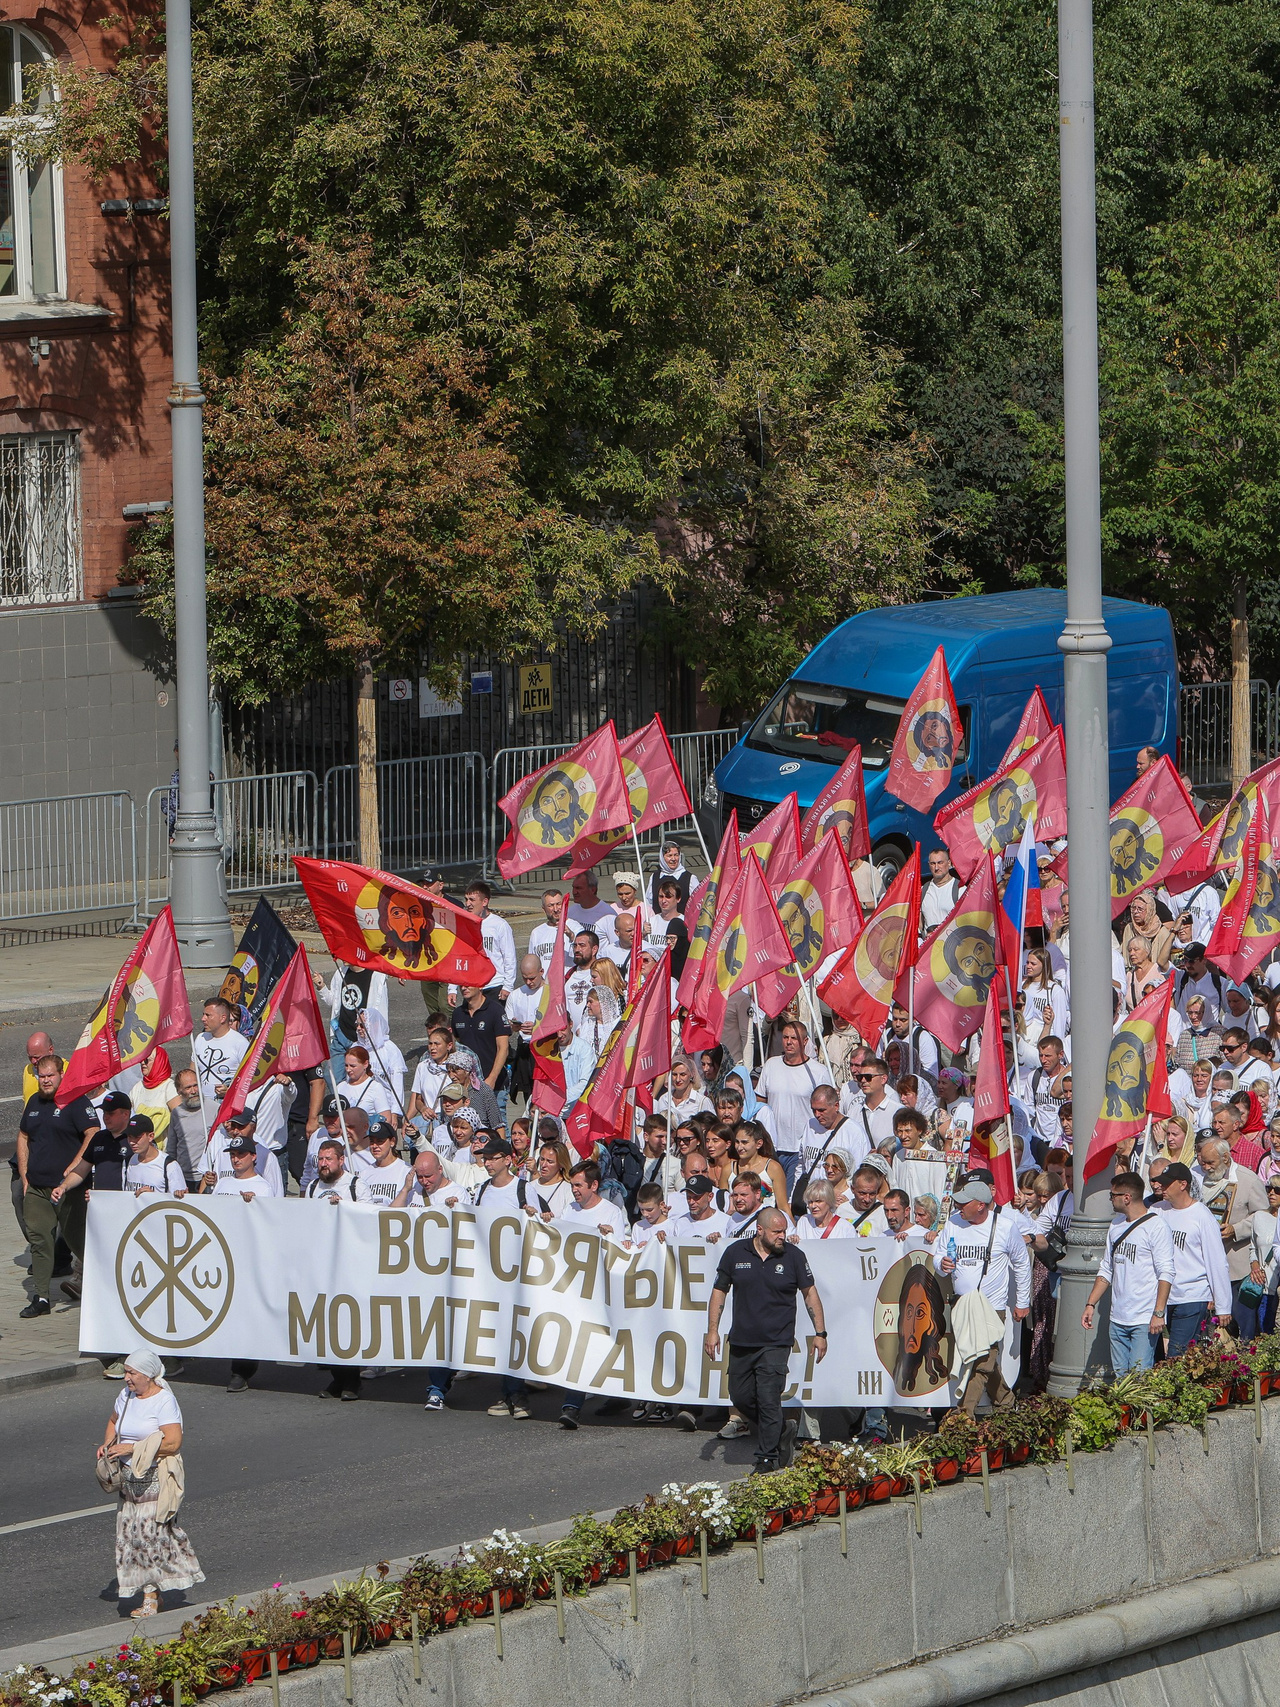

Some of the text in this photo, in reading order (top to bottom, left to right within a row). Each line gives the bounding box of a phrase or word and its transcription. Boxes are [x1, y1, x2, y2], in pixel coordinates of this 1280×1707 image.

[523, 688, 550, 711] ДЕТИ
[369, 1183, 397, 1200] УССКАЯ
[378, 1211, 707, 1311] ВСЕ СВЯТЫЕ
[957, 1245, 990, 1261] УССКА
[288, 1292, 815, 1401] МОЛИТЕ БОГА О Н!
